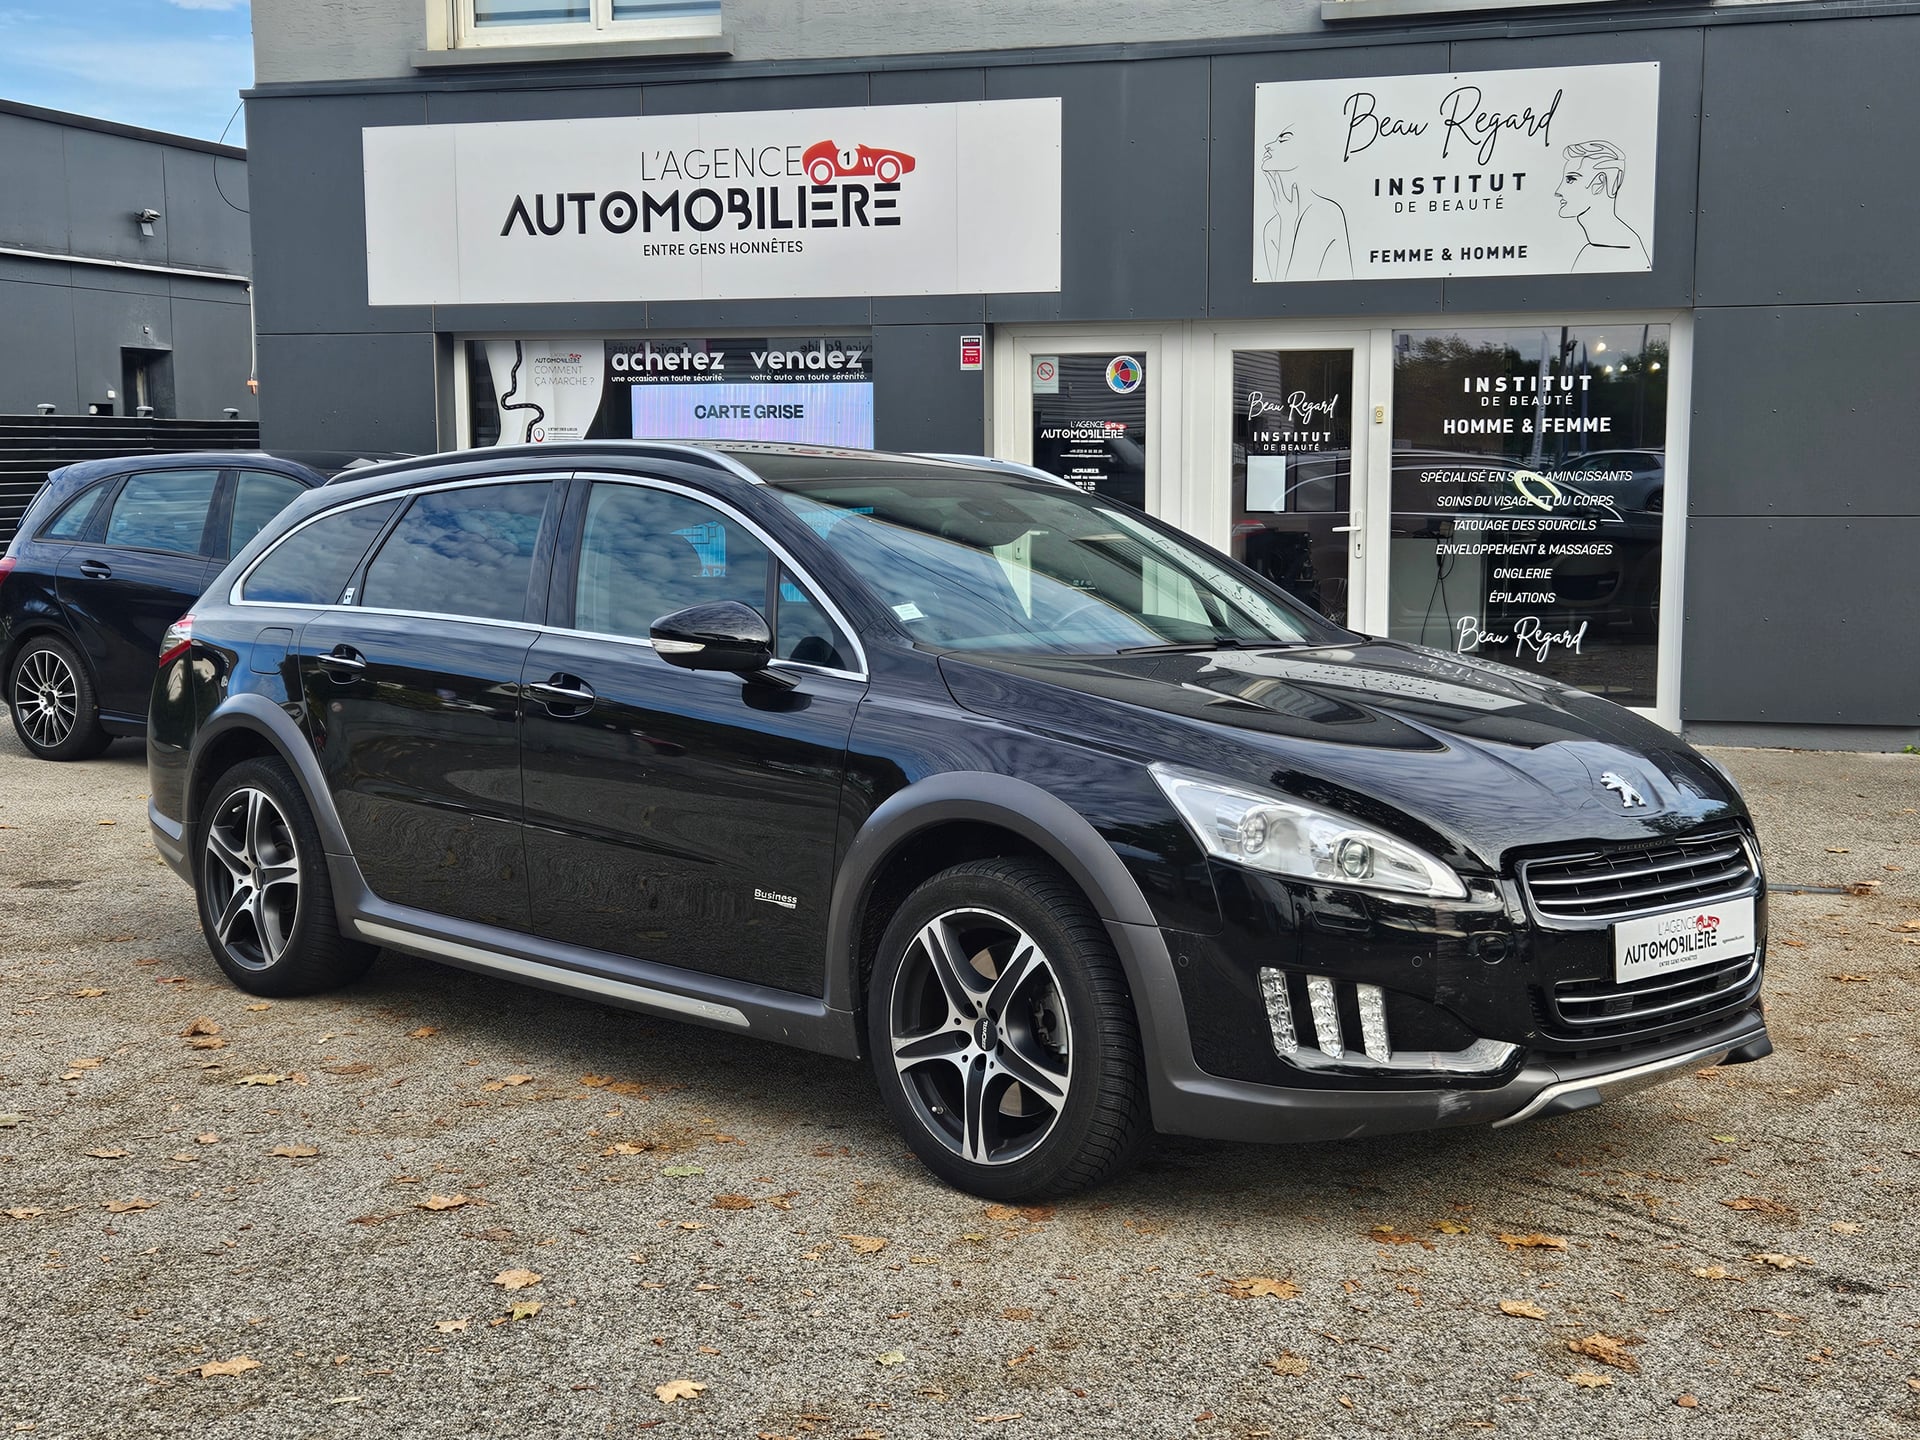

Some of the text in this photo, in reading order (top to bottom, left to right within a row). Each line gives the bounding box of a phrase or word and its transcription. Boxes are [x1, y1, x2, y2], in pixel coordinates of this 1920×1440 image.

[1344, 86, 1563, 166] Beau Regard
[642, 146, 803, 181] L'AGENCE
[1375, 173, 1526, 197] INSTITUT
[500, 182, 901, 237] AUTOMOBILIERE
[1395, 195, 1504, 213] DE BEAUTÉ
[643, 238, 803, 256] ENTRE GENS HONNÊTES
[1370, 245, 1528, 263] FEMME & HOMME
[611, 339, 863, 371] achetez vendez
[534, 366, 583, 375] COMMENT
[627, 373, 658, 382] occasion
[671, 374, 691, 382] toute
[693, 372, 725, 382] sécurité.
[750, 373, 772, 381] votre
[774, 373, 793, 381] auto
[808, 373, 830, 381] toute
[832, 371, 867, 380] sérénité.
[534, 377, 547, 387] ÇA
[548, 376, 587, 386] MARCHE
[1464, 375, 1592, 393] INSTITUT
[1248, 390, 1339, 425] Beau Regard
[1481, 393, 1573, 407] DE BEAUTÉ
[694, 404, 804, 419] CARTE GRISE
[1070, 420, 1104, 429] L'AGENCE
[1443, 416, 1612, 434] HOMME & FEMME
[1253, 431, 1331, 442] INSTITUT
[1280, 443, 1319, 451] BEAUTÉ
[1420, 469, 1487, 483] SPÉCIALISÉ
[1488, 471, 1505, 482] EN
[1545, 470, 1633, 481] AMINCISSANTS
[1437, 496, 1473, 507] SOINS
[1474, 496, 1492, 507] DU
[1494, 495, 1535, 507] VISAGE
[1553, 496, 1571, 507] DU
[1573, 495, 1615, 506] CORPS
[1453, 520, 1597, 531] TATOUAGE DES SOURCILS
[1436, 543, 1613, 555] ENVELOPPEMENT & MASSAGES
[1493, 568, 1553, 579] ONGLERIE
[1489, 590, 1556, 603] ÉPILATIONS
[1456, 616, 1588, 663] Beau Regard
[754, 888, 798, 904] Business
[1658, 916, 1697, 936] L'AGENCE
[1623, 929, 1718, 966] AUTOMOBILIERE
